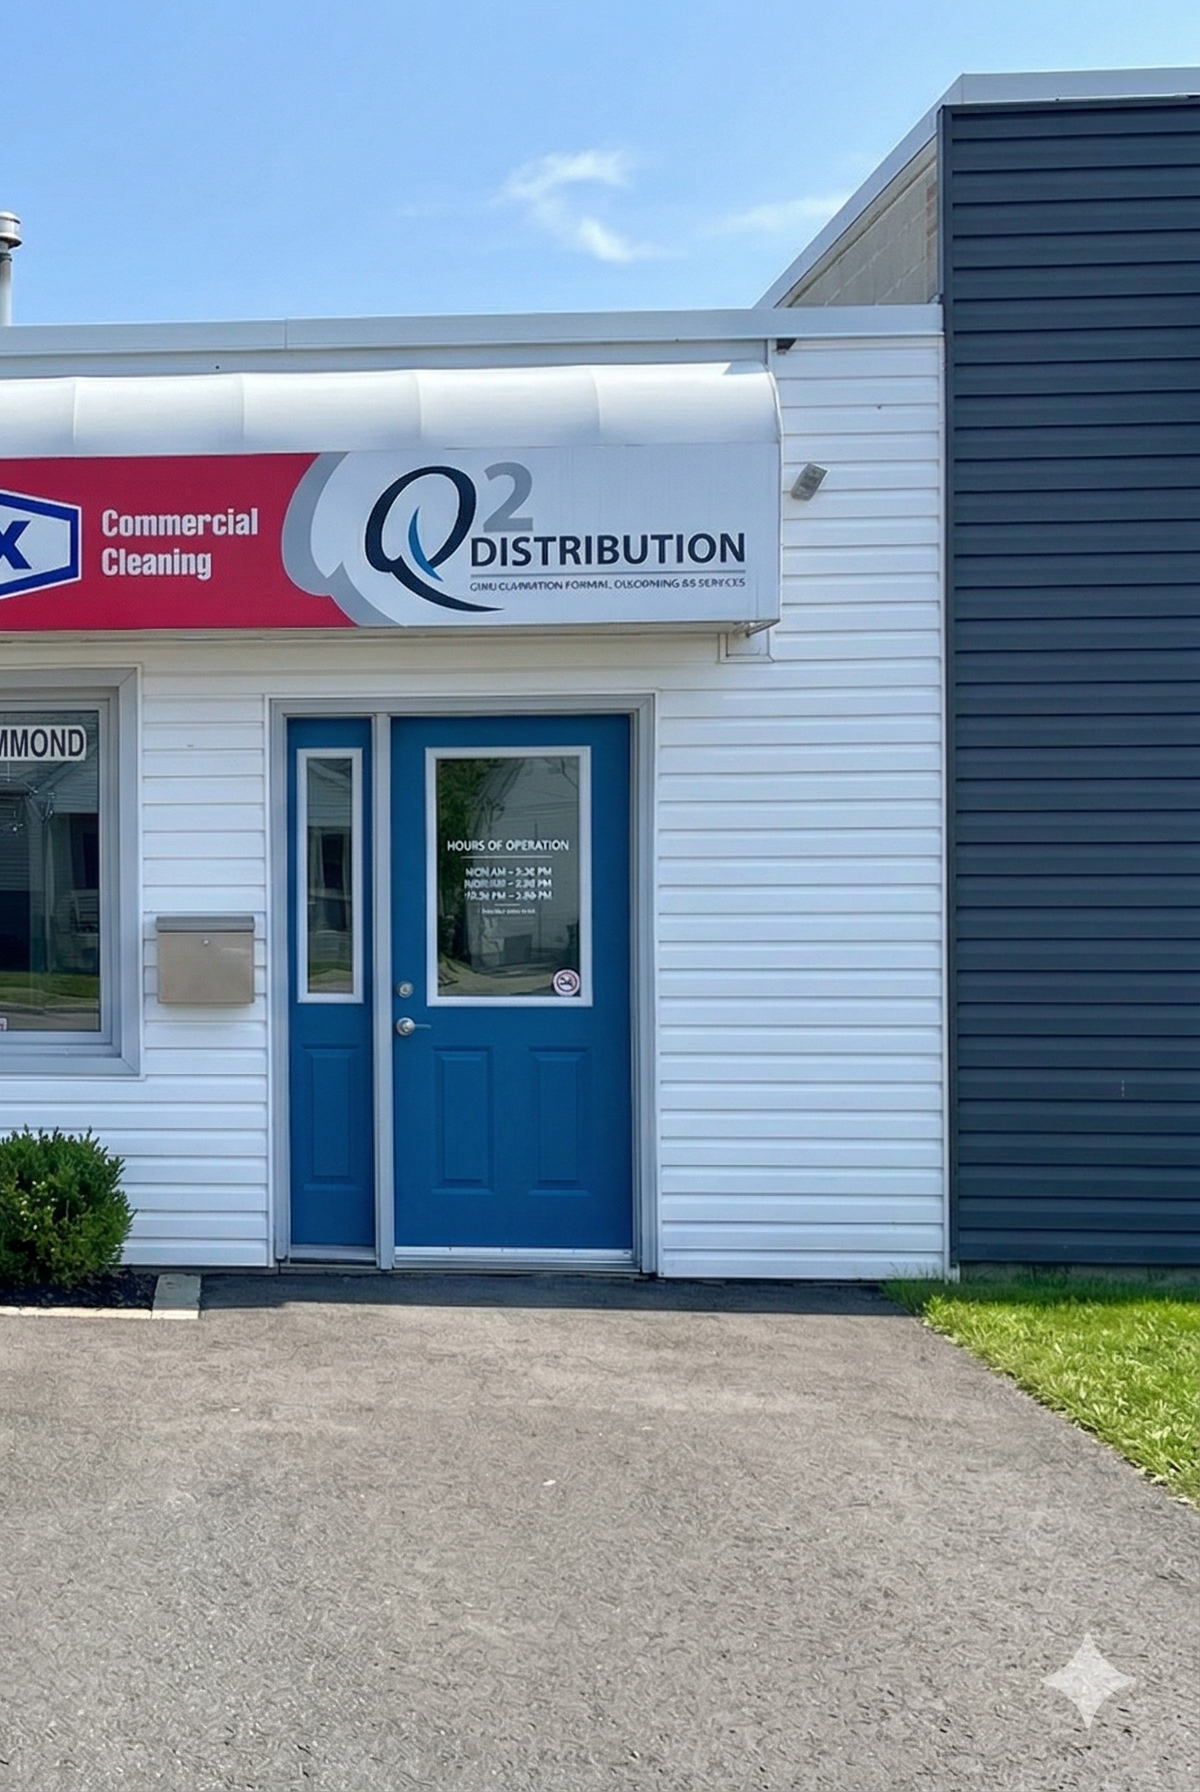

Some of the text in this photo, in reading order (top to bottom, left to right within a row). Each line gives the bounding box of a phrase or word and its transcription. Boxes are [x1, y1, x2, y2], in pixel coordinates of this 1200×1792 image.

[101, 508, 259, 537] Commercial
[101, 548, 212, 581] Cleaning
[470, 532, 746, 567] DISTRIBUTION
[447, 840, 569, 852] HOURS OF OPERATION
